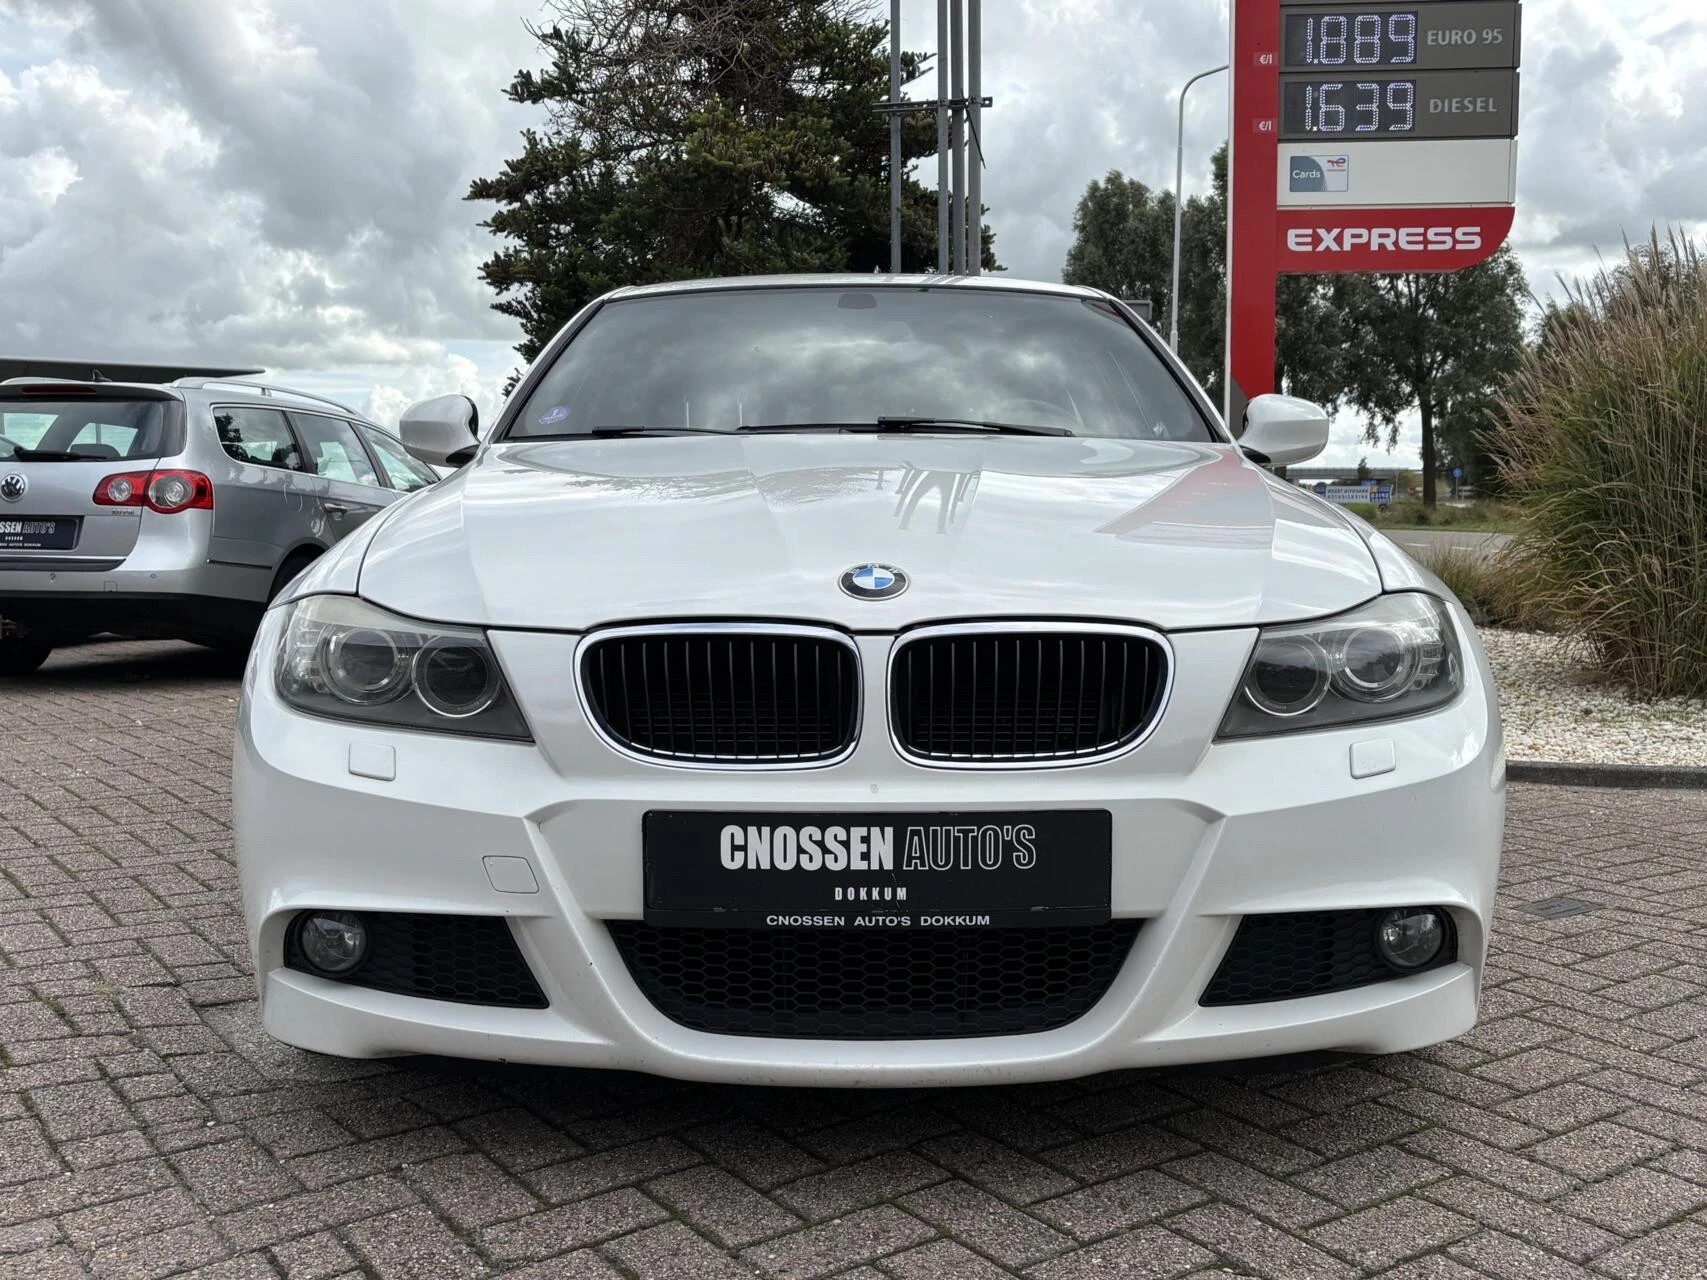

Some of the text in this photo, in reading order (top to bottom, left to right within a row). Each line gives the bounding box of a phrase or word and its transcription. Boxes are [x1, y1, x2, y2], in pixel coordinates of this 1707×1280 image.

[1306, 14, 1416, 64] 1.889
[1427, 28, 1503, 46] EURO 95
[1305, 82, 1414, 132] 1.639
[1429, 97, 1498, 114] DIESEL
[1292, 169, 1321, 179] Cards
[1287, 226, 1482, 252] EXPRESS
[720, 824, 1037, 872] CNOSSEN AUTO'S
[834, 886, 908, 902] DOKKUM
[766, 914, 991, 927] CNOSSEN AUTO'S DOKKUM
